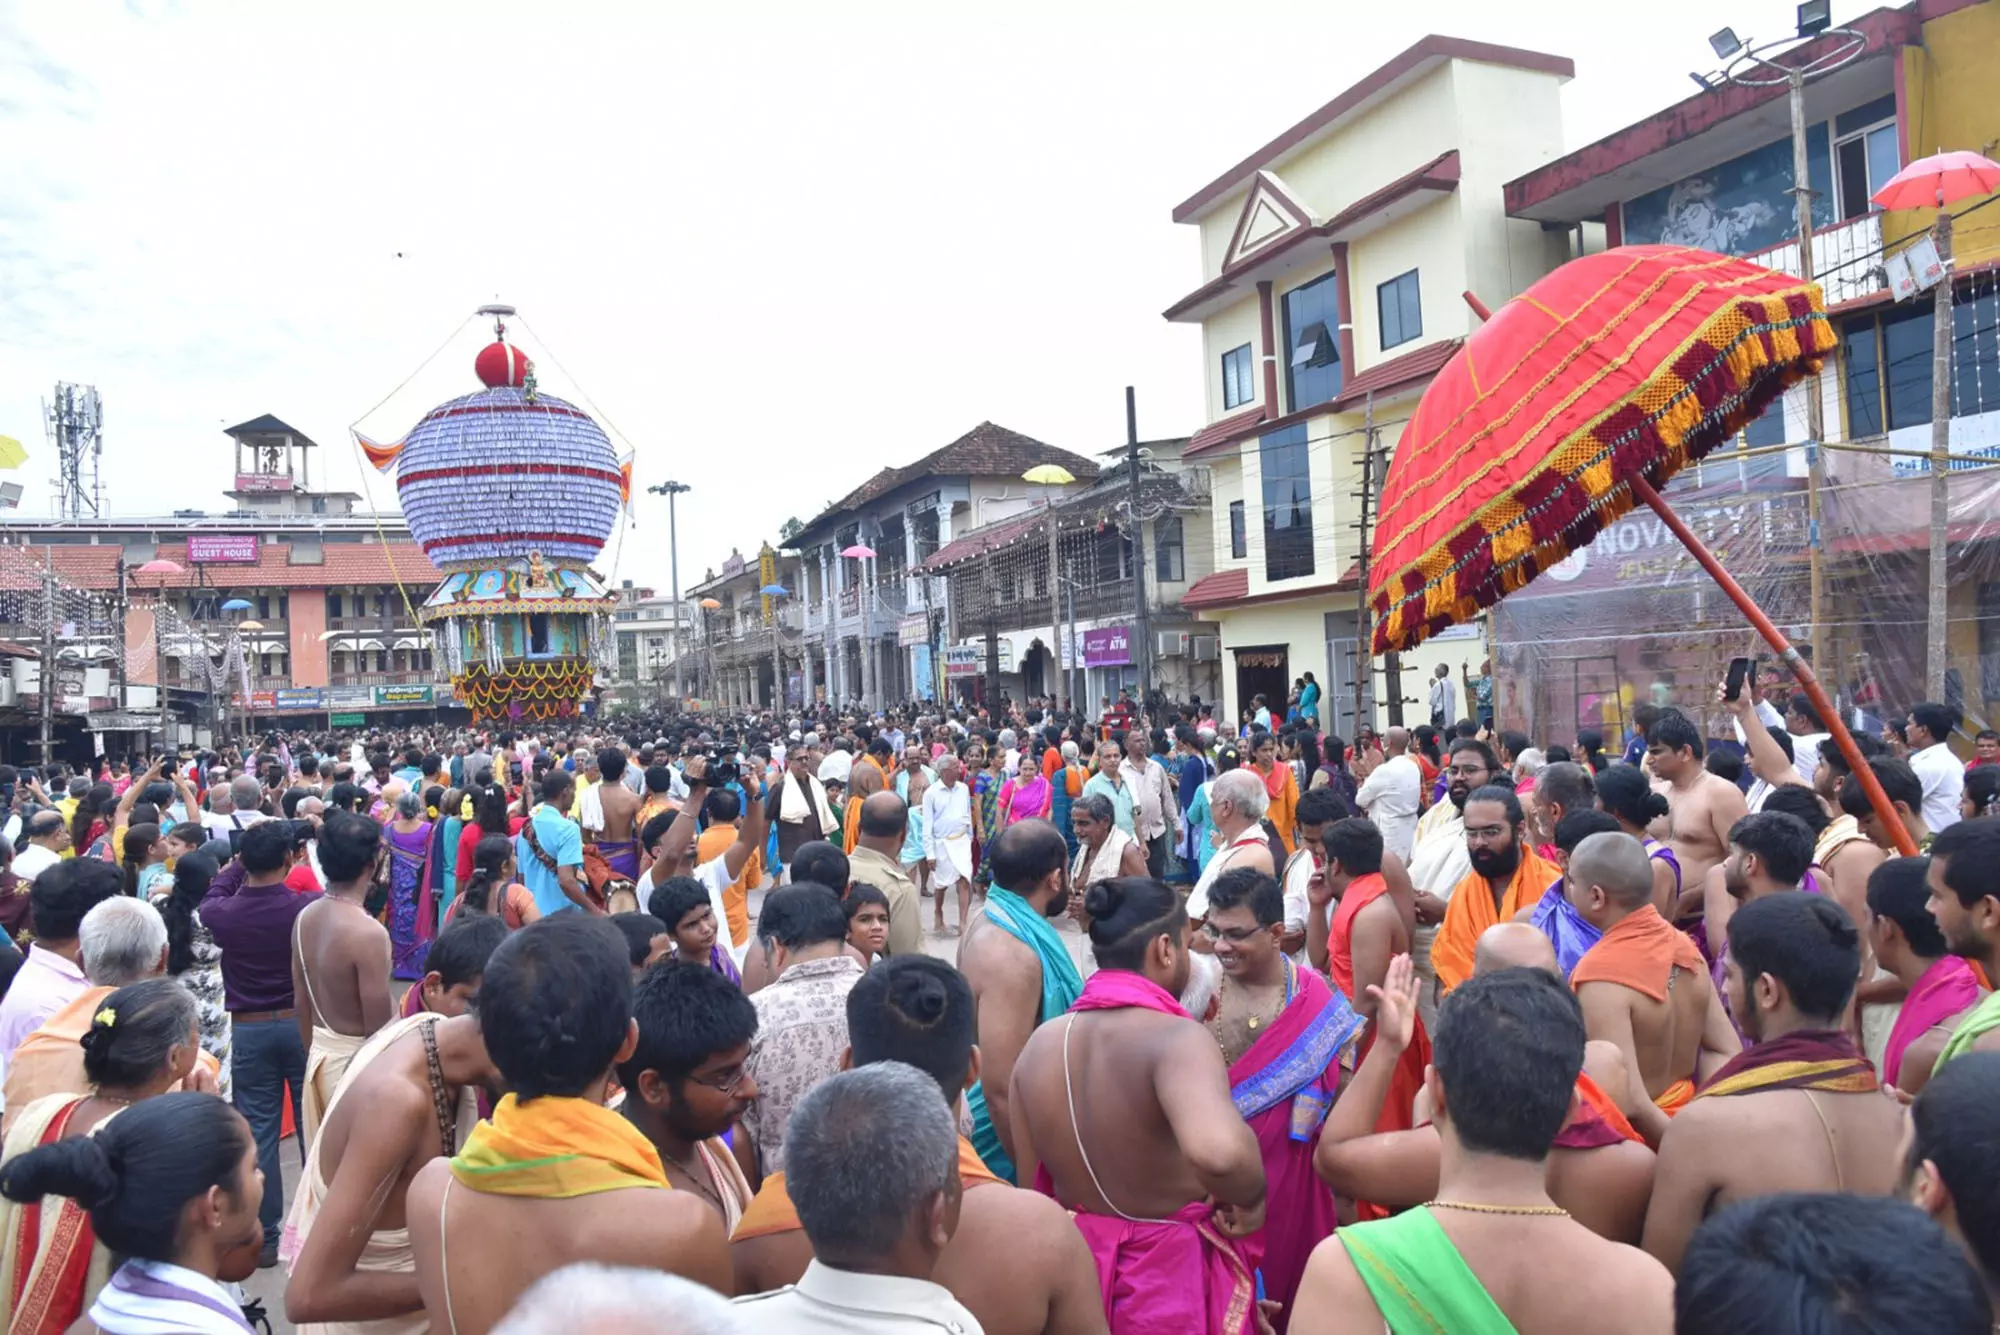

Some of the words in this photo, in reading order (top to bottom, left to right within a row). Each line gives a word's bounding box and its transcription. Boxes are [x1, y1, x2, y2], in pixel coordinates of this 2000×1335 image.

[1595, 505, 1744, 555] NOVTY
[192, 549, 221, 557] GUEST
[223, 549, 253, 557] HOUSE
[1110, 638, 1127, 650] ATM
